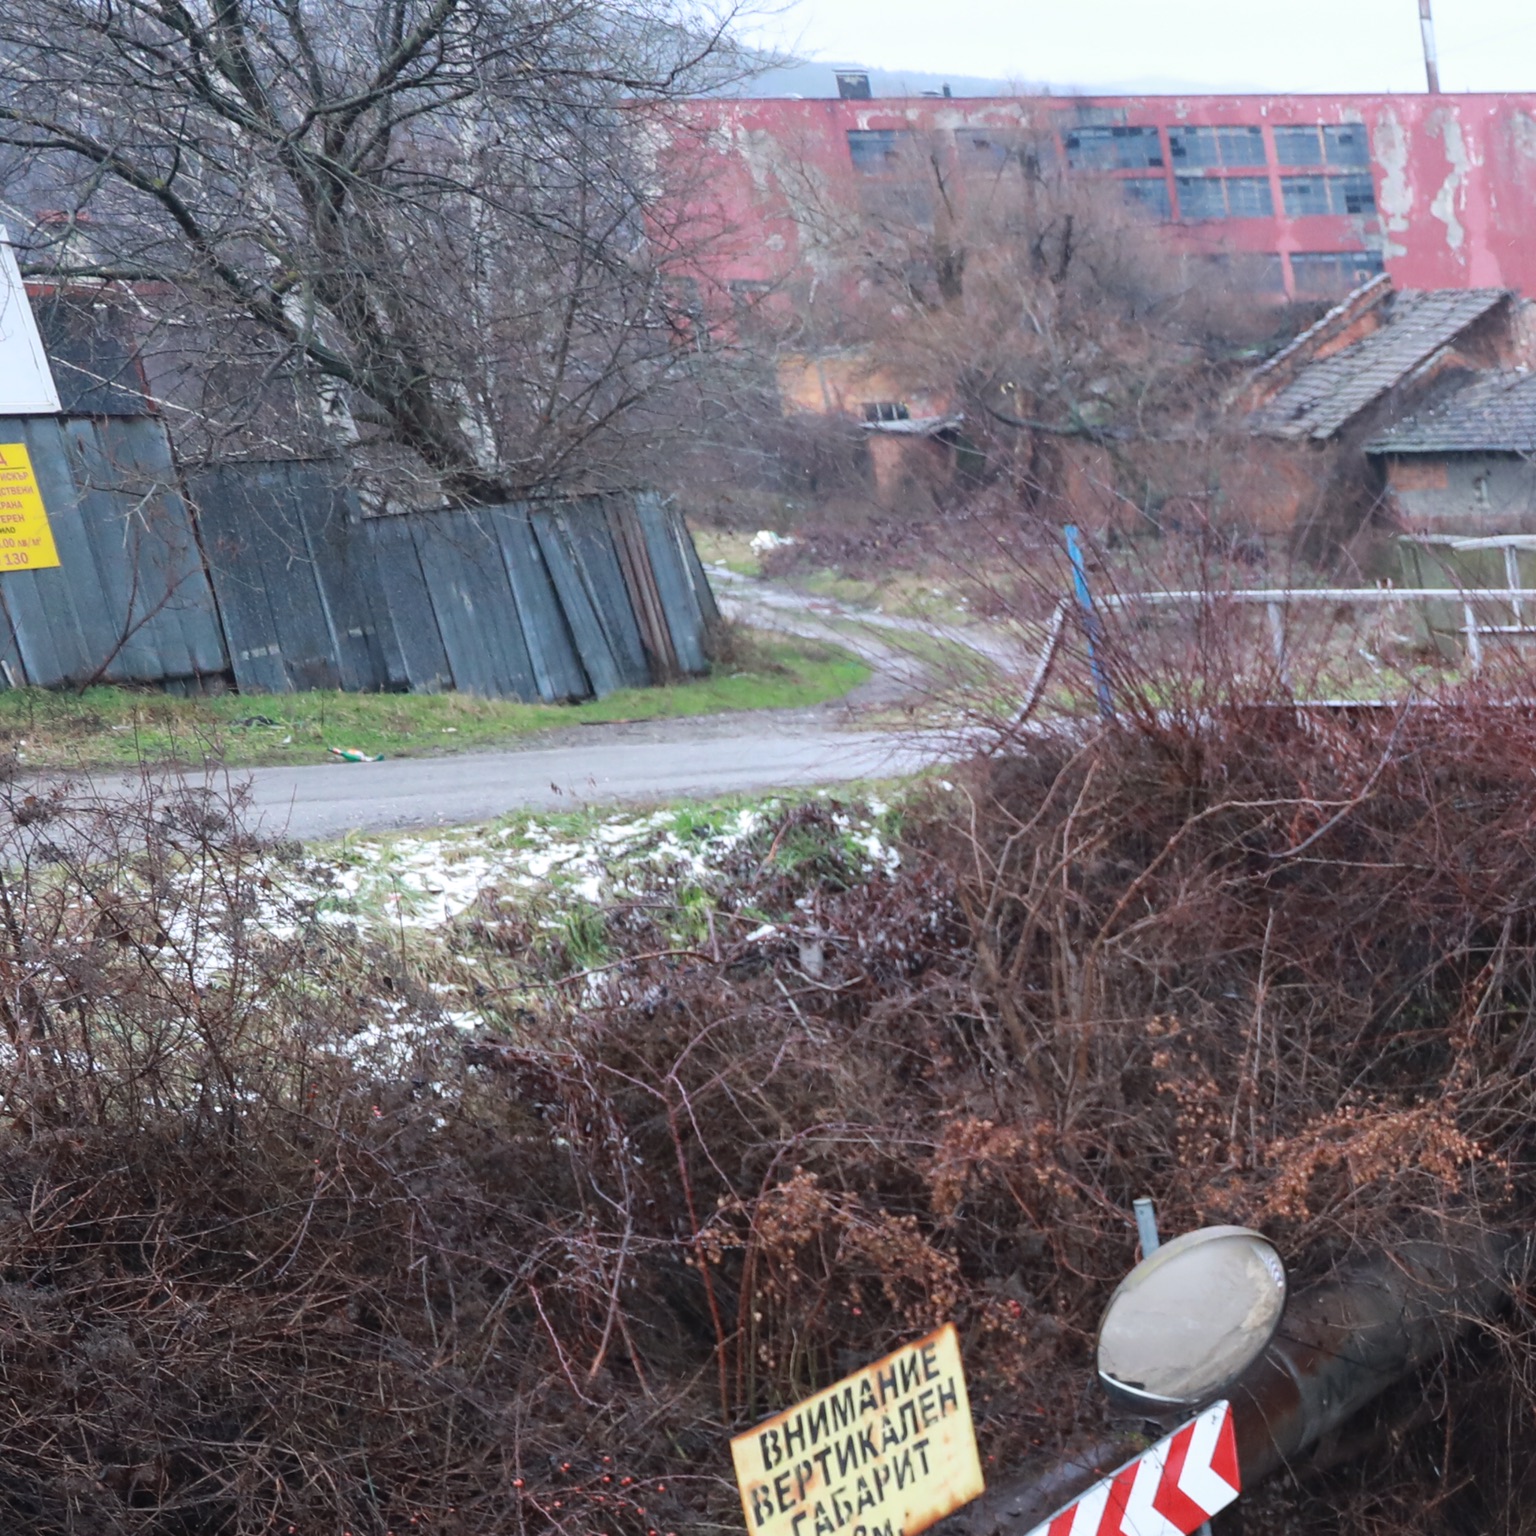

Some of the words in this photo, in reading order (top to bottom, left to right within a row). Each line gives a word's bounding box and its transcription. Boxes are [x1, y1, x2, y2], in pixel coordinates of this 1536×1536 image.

[0, 485, 34, 496] СТВЕНИ
[0, 500, 23, 510] РАНА
[4, 552, 29, 566] 130
[759, 1342, 941, 1470] ВНИМАНИЕ
[750, 1376, 958, 1527] ВЕРТИКАЛЕН
